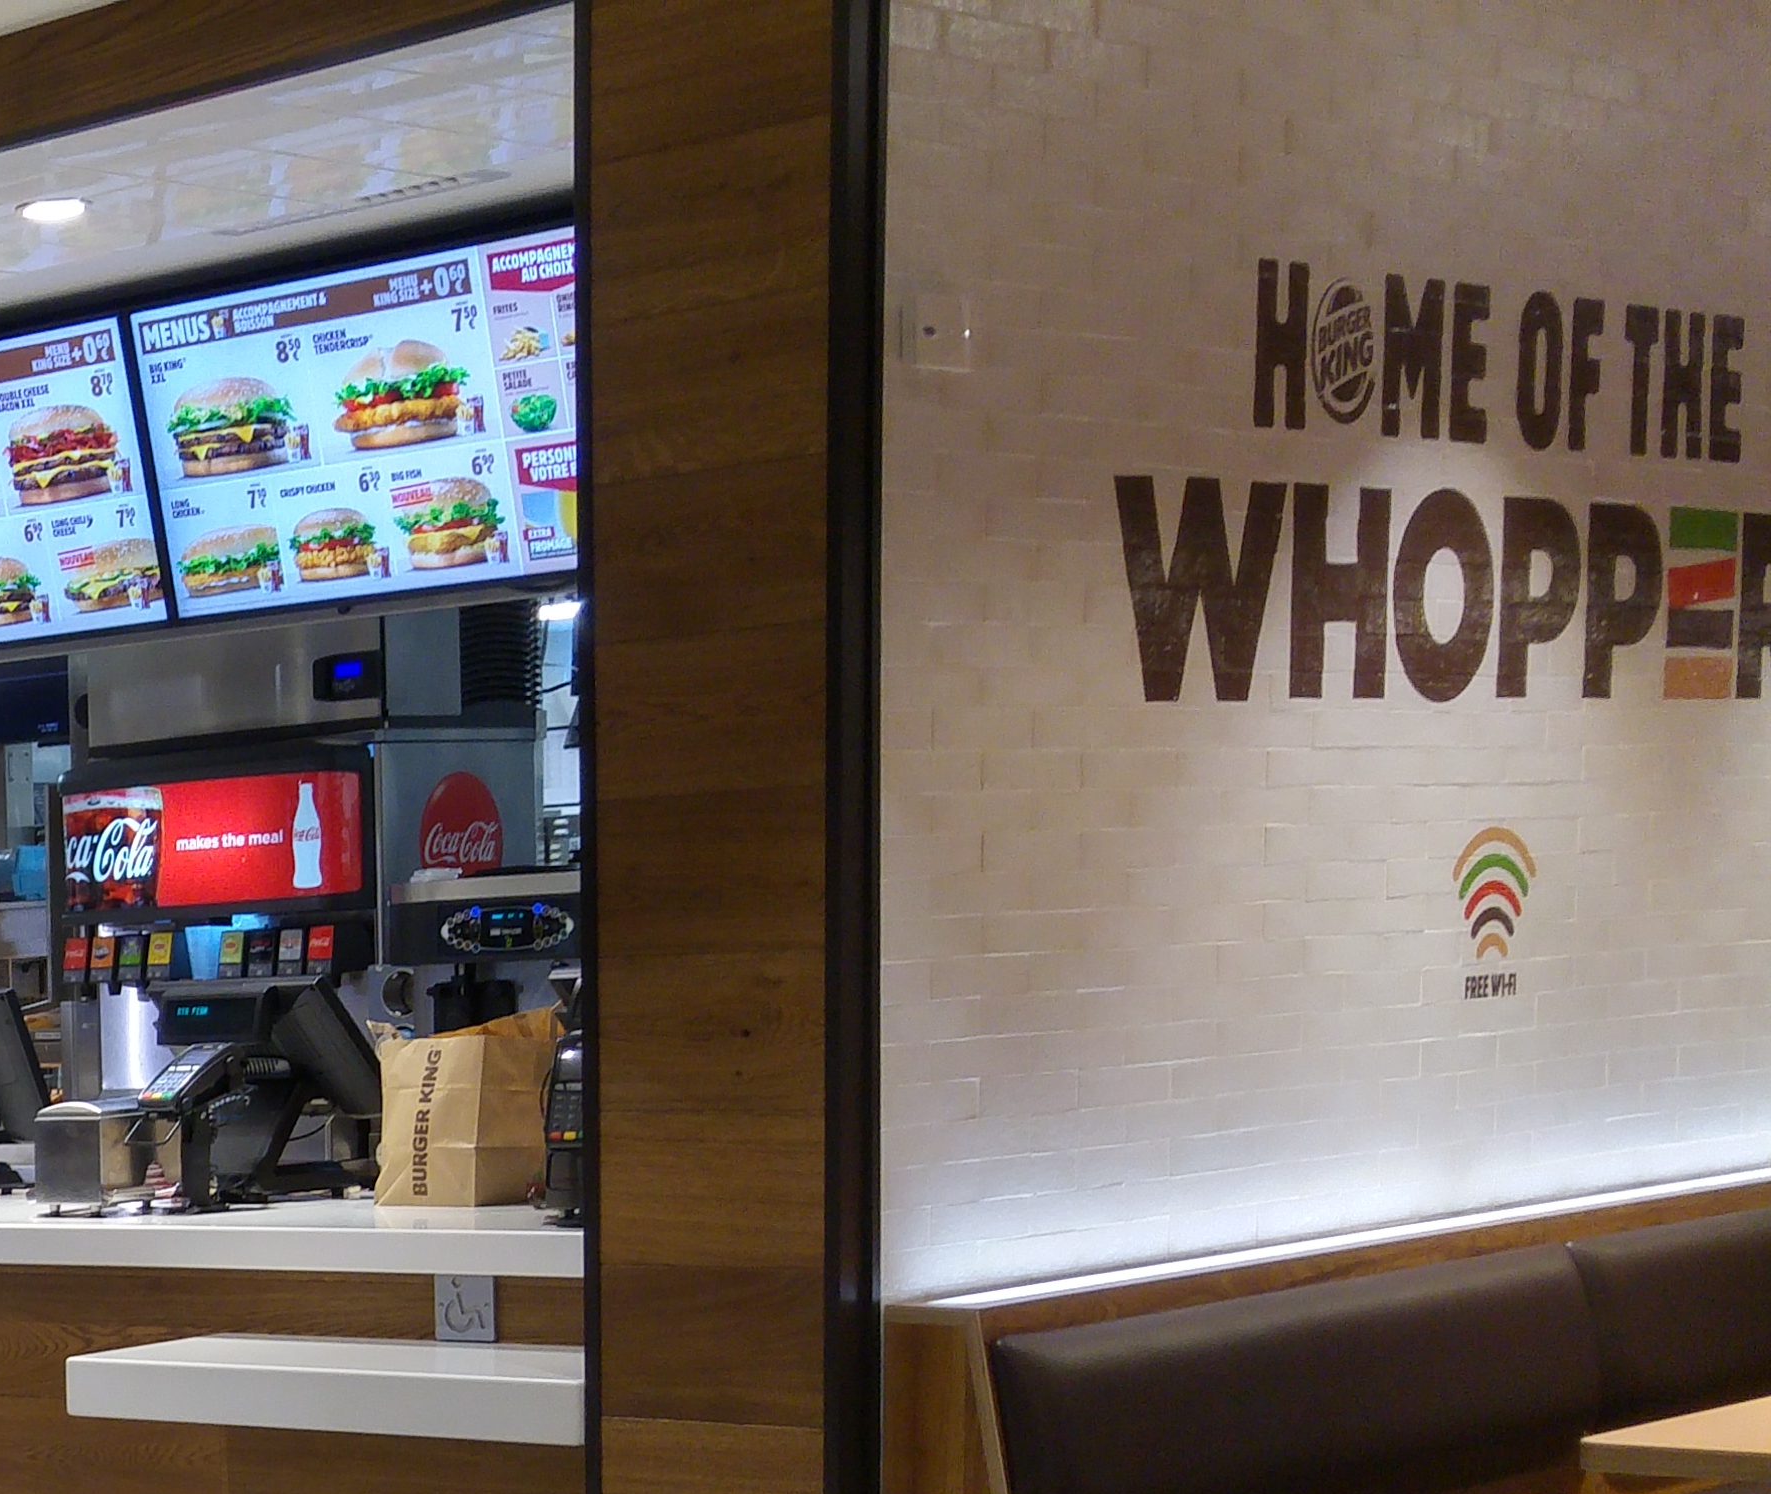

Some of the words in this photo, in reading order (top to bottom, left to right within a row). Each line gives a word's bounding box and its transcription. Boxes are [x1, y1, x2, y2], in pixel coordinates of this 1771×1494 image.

[521, 266, 538, 284] AU
[538, 259, 574, 279] CHOIX
[388, 273, 419, 292] MENU
[232, 293, 317, 319] ACCOMPAGNEMENT
[373, 291, 398, 308] KING
[398, 286, 421, 303] SIZE
[492, 302, 519, 316] FRITES
[141, 314, 211, 351] MENUS
[233, 314, 275, 334] BOISSON
[312, 328, 347, 344] CHICKEN
[44, 341, 70, 358] MENU
[314, 336, 370, 356] TENDERCRISP
[31, 359, 53, 373] KING
[52, 354, 72, 369] SIZE
[148, 362, 164, 374] BIG
[164, 357, 185, 372] KING
[1318, 331, 1375, 395] KING
[150, 373, 167, 385] XXL
[502, 369, 527, 382] PETITE
[503, 378, 532, 392] SALADE
[1516, 290, 1606, 452] OF
[1625, 303, 1745, 463] THE
[23, 384, 50, 398] CHEESE
[20, 398, 35, 409] XXL
[391, 470, 406, 482] BIG
[405, 468, 423, 480] FISH
[530, 462, 569, 482] VOTRE
[279, 485, 305, 499] CRISPY
[305, 480, 336, 495] CHICKEN
[390, 486, 433, 504] NOUVEAU
[171, 498, 191, 510] LONG
[172, 507, 201, 519] CHICKEN
[51, 516, 70, 530] LONG
[69, 514, 87, 526] CHILI
[52, 527, 78, 538] CHEESE
[176, 835, 220, 852] makes
[220, 832, 245, 849] the
[247, 828, 284, 847] meal
[424, 820, 499, 865] Coca-Cola
[1464, 974, 1489, 1000] FREE
[1490, 972, 1517, 998] WI-FI
[176, 1005, 190, 1017] BIG
[191, 1005, 209, 1016] FISH
[419, 1048, 442, 1104] KING
[412, 1108, 431, 1197] BURGER
